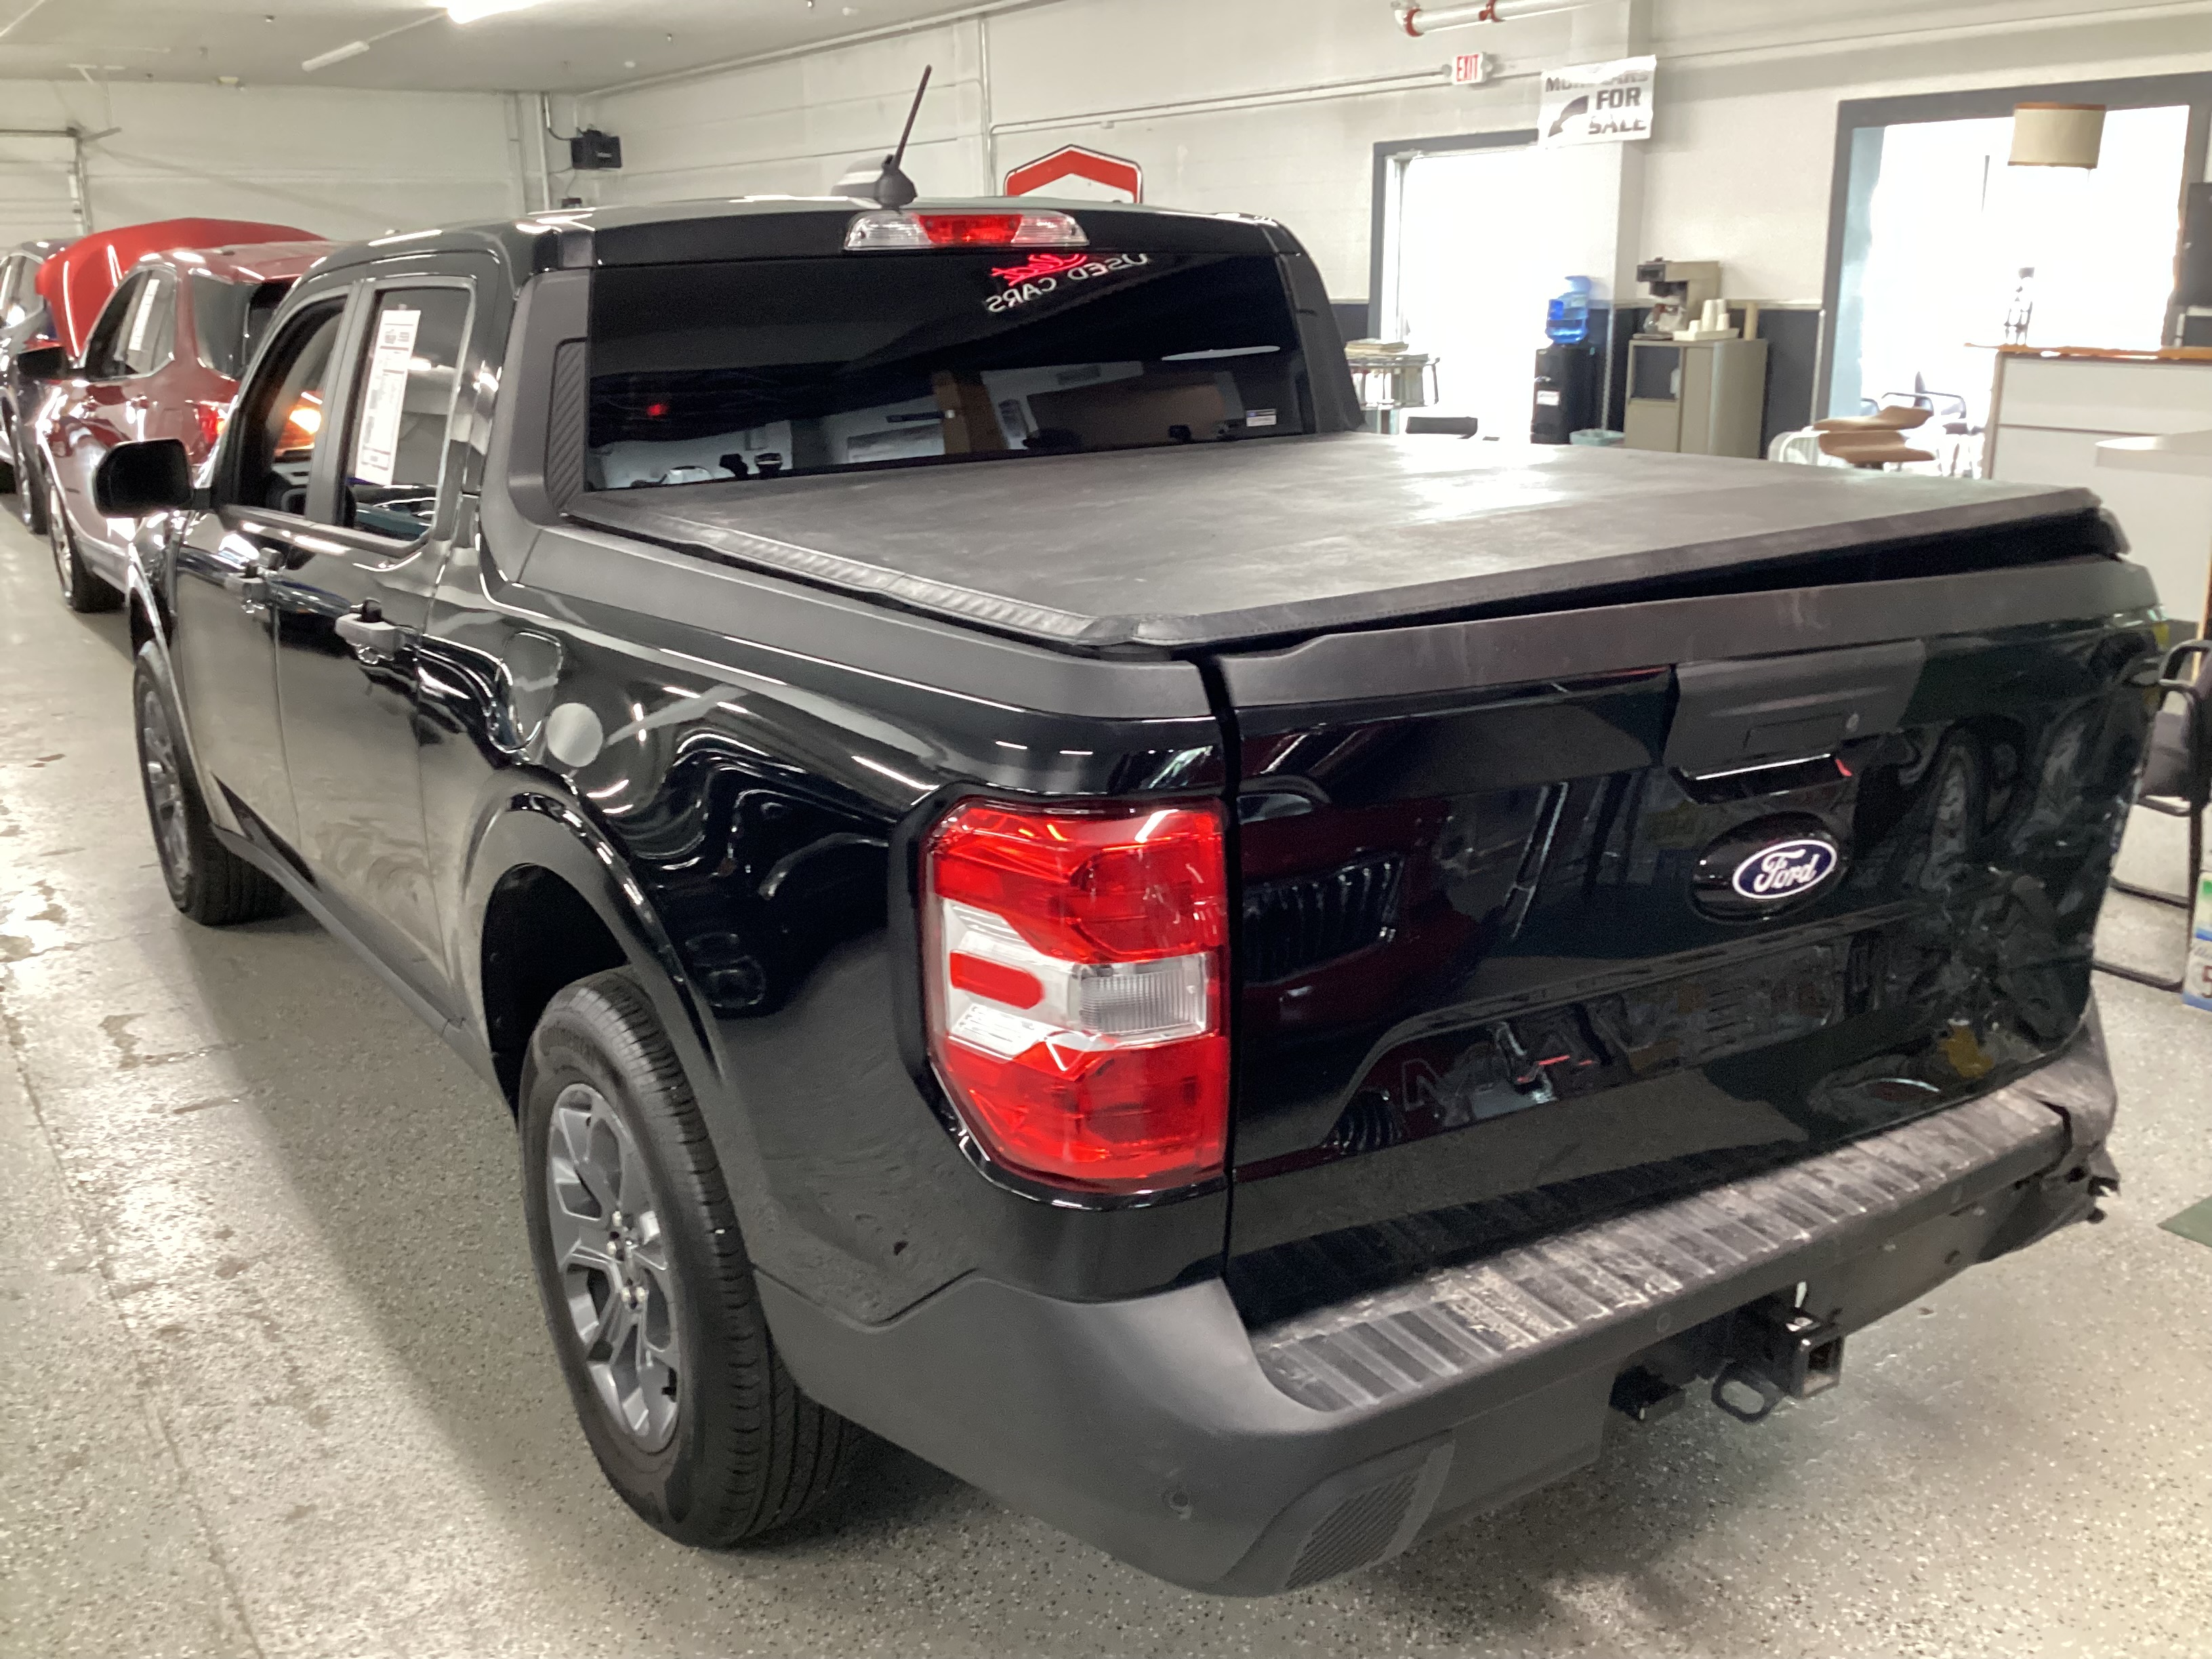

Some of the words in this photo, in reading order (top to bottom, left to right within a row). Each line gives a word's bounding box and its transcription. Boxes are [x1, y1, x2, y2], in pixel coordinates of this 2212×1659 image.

[1456, 54, 1478, 81] EXIT
[1595, 87, 1641, 110] FOR
[1588, 115, 1647, 135] SALE
[1753, 848, 1820, 893] Ford
